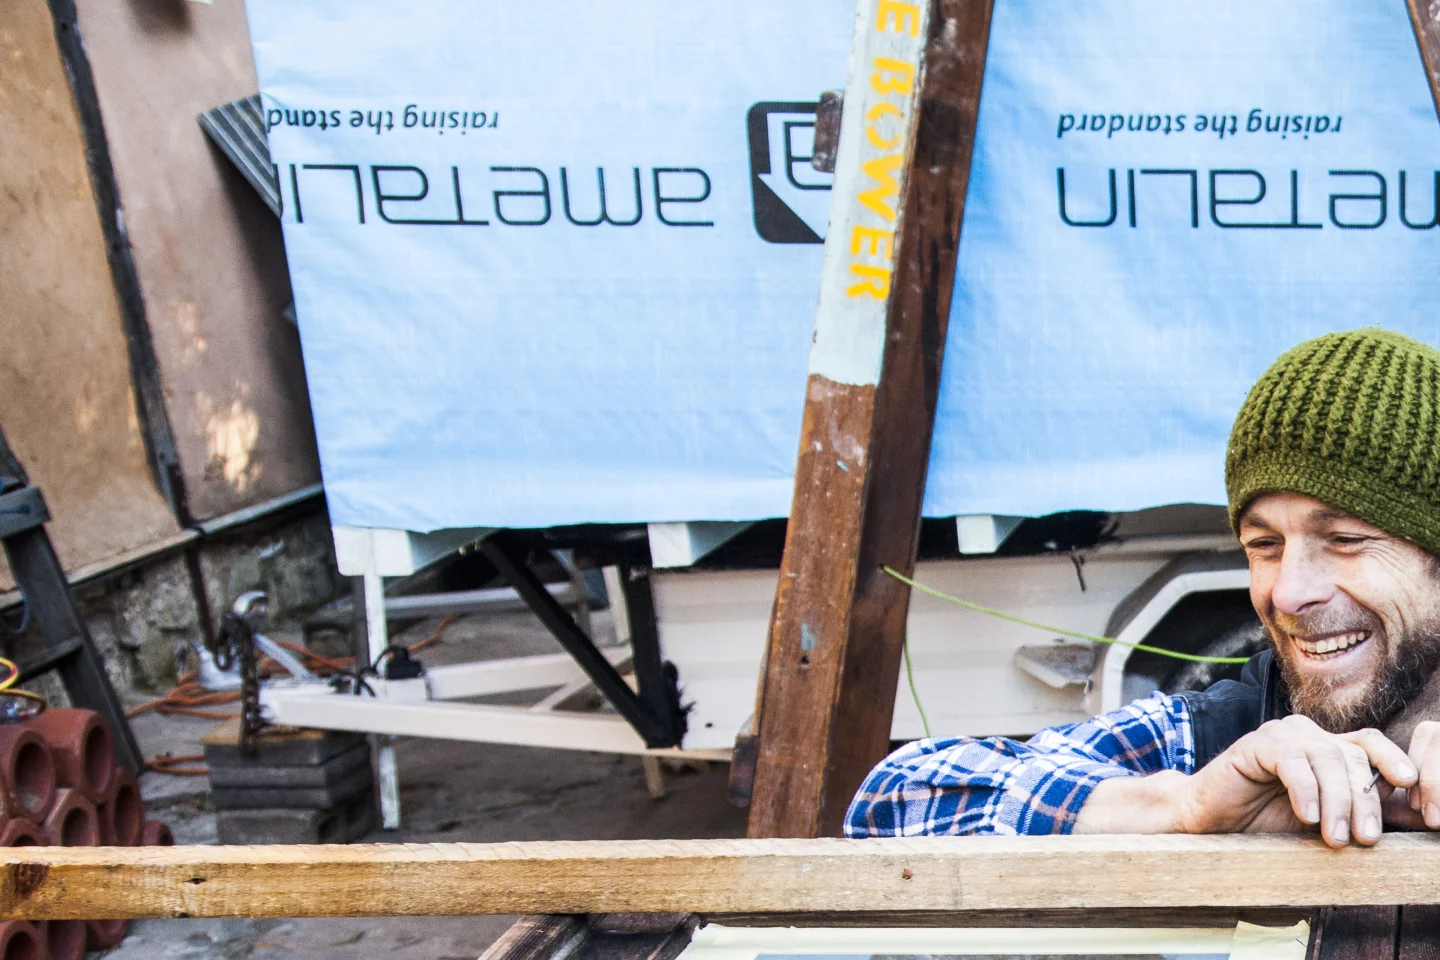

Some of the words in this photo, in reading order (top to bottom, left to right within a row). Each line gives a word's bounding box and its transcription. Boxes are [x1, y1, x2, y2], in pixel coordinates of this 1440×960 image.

[266, 108, 341, 134] stand
[349, 109, 395, 135] the
[403, 104, 498, 135] raising
[1056, 112, 1187, 139] standard
[1194, 113, 1239, 139] the
[1246, 109, 1343, 139] raising
[846, 56, 916, 301] BOWER
